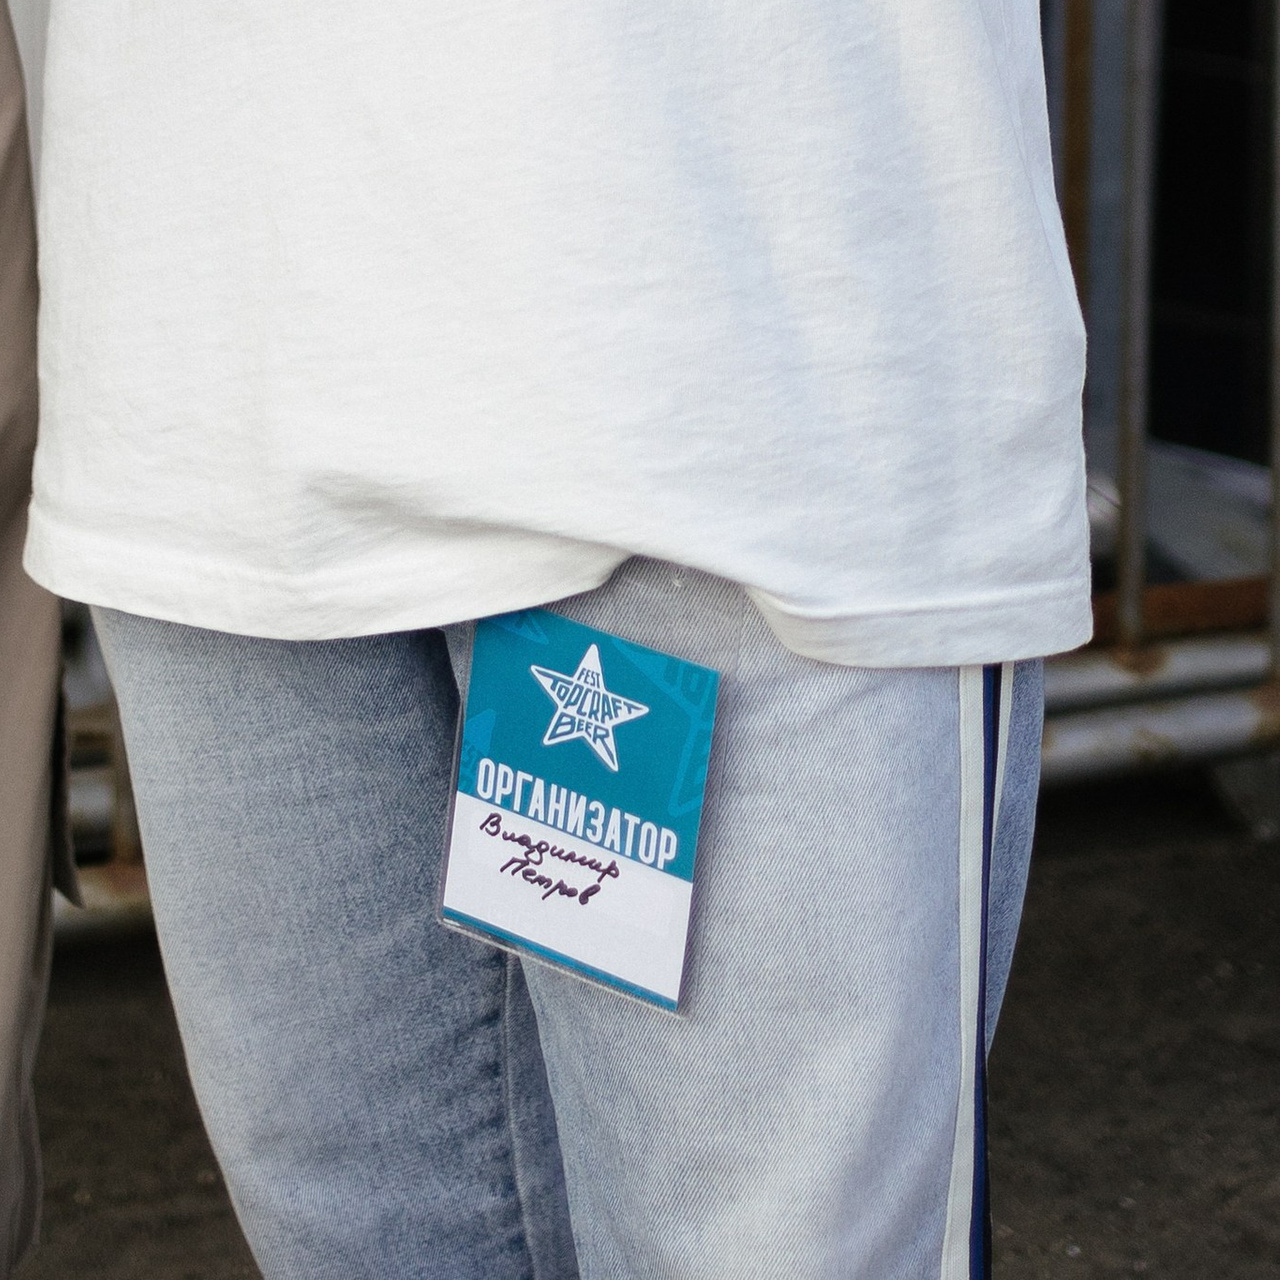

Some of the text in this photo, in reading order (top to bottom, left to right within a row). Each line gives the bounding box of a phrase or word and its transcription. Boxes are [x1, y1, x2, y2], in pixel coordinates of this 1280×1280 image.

[535, 668, 644, 723] TOPCRAFT
[576, 667, 601, 689] FEST
[547, 711, 616, 768] BEER
[477, 757, 678, 870] ОРГАНИЗАТОР
[479, 812, 620, 883] Владимир
[500, 857, 601, 906] Петров
